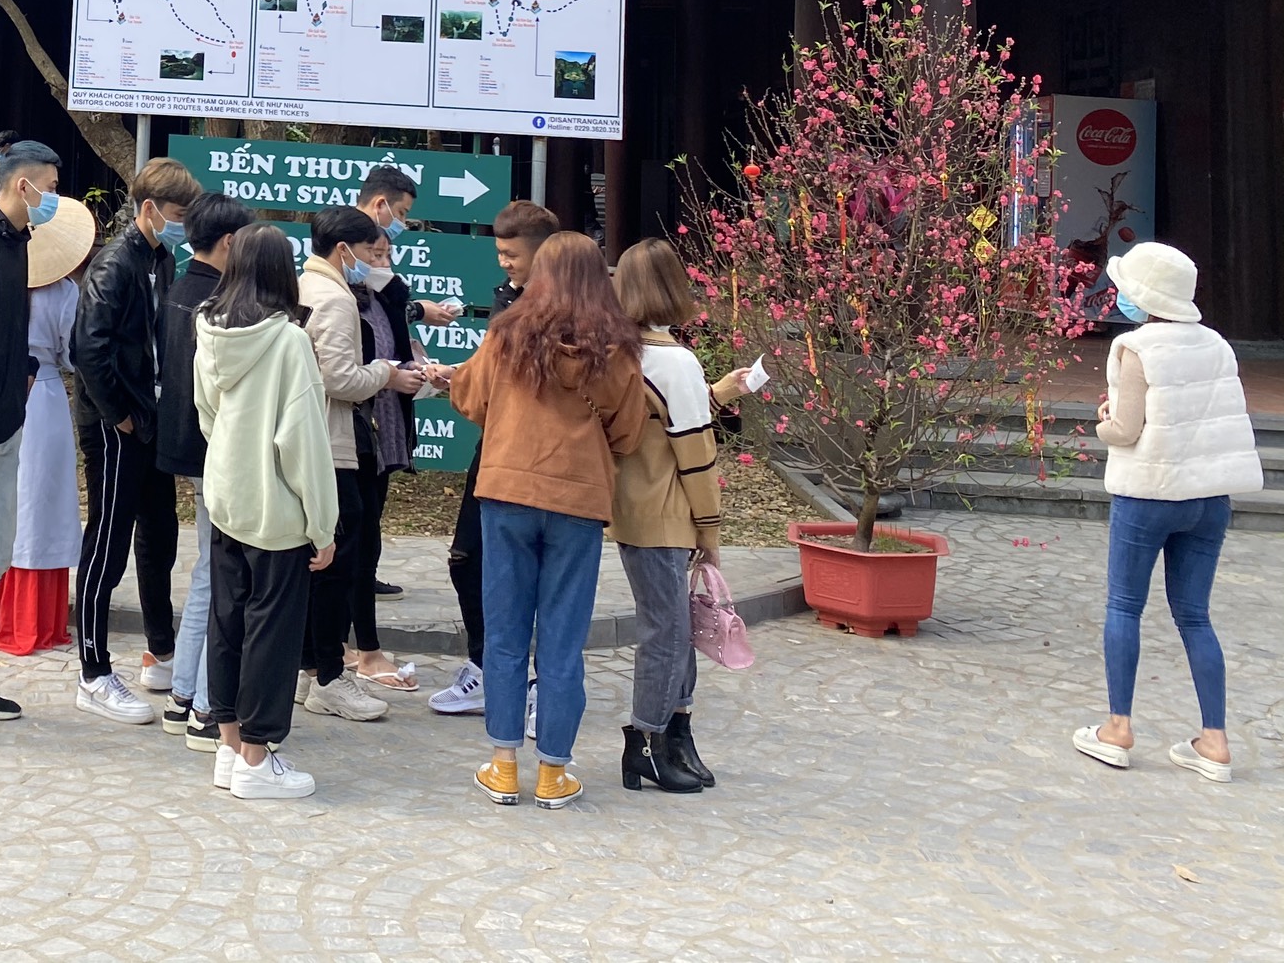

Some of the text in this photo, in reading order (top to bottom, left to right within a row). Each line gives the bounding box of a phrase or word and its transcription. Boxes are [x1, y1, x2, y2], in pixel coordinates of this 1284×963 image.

[89, 91, 112, 99] KHÁCH
[197, 97, 216, 105] THAM
[242, 99, 254, 107] GIÁ
[208, 143, 276, 176] BẾN
[222, 180, 361, 207] BOAT STAT
[391, 239, 431, 268] VÉ
[407, 273, 464, 297] NTER
[416, 321, 488, 350] VIÊN
